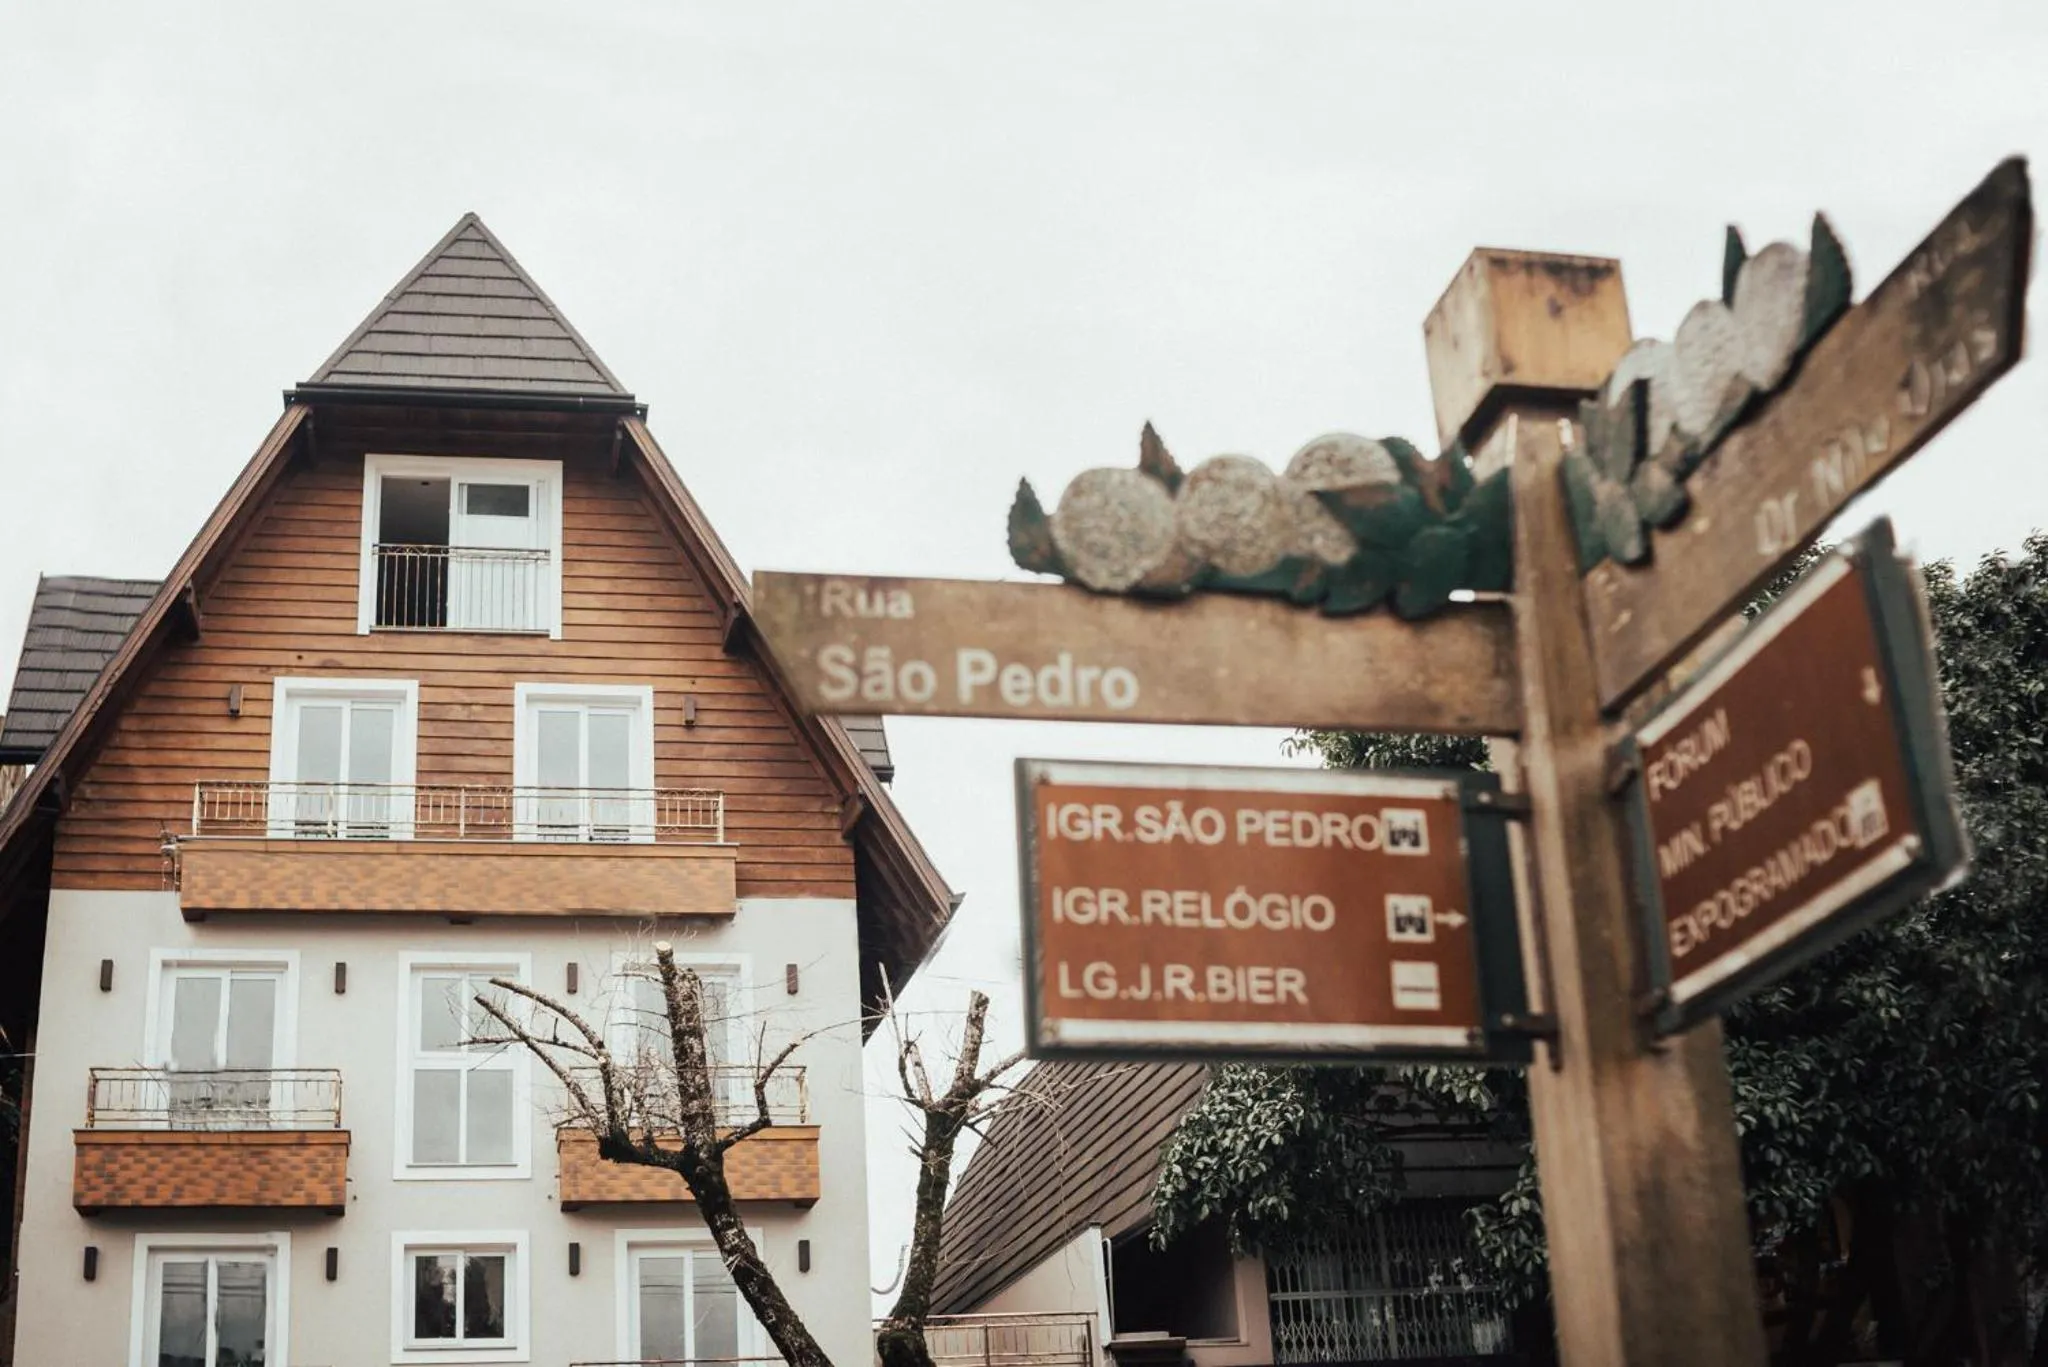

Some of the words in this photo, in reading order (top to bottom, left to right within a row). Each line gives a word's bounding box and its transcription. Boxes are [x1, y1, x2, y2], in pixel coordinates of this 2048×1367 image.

[819, 580, 914, 620] Rua
[817, 643, 937, 703] São
[957, 648, 1140, 709] Pedro
[1708, 737, 1812, 844] PÚBLICO
[1236, 808, 1382, 851] PEDRO
[1668, 804, 1854, 958] EXPOGRAMADO
[1051, 886, 1336, 932] IGR.RELÓGIO
[1057, 960, 1309, 1005] LG.J.R.BIER
